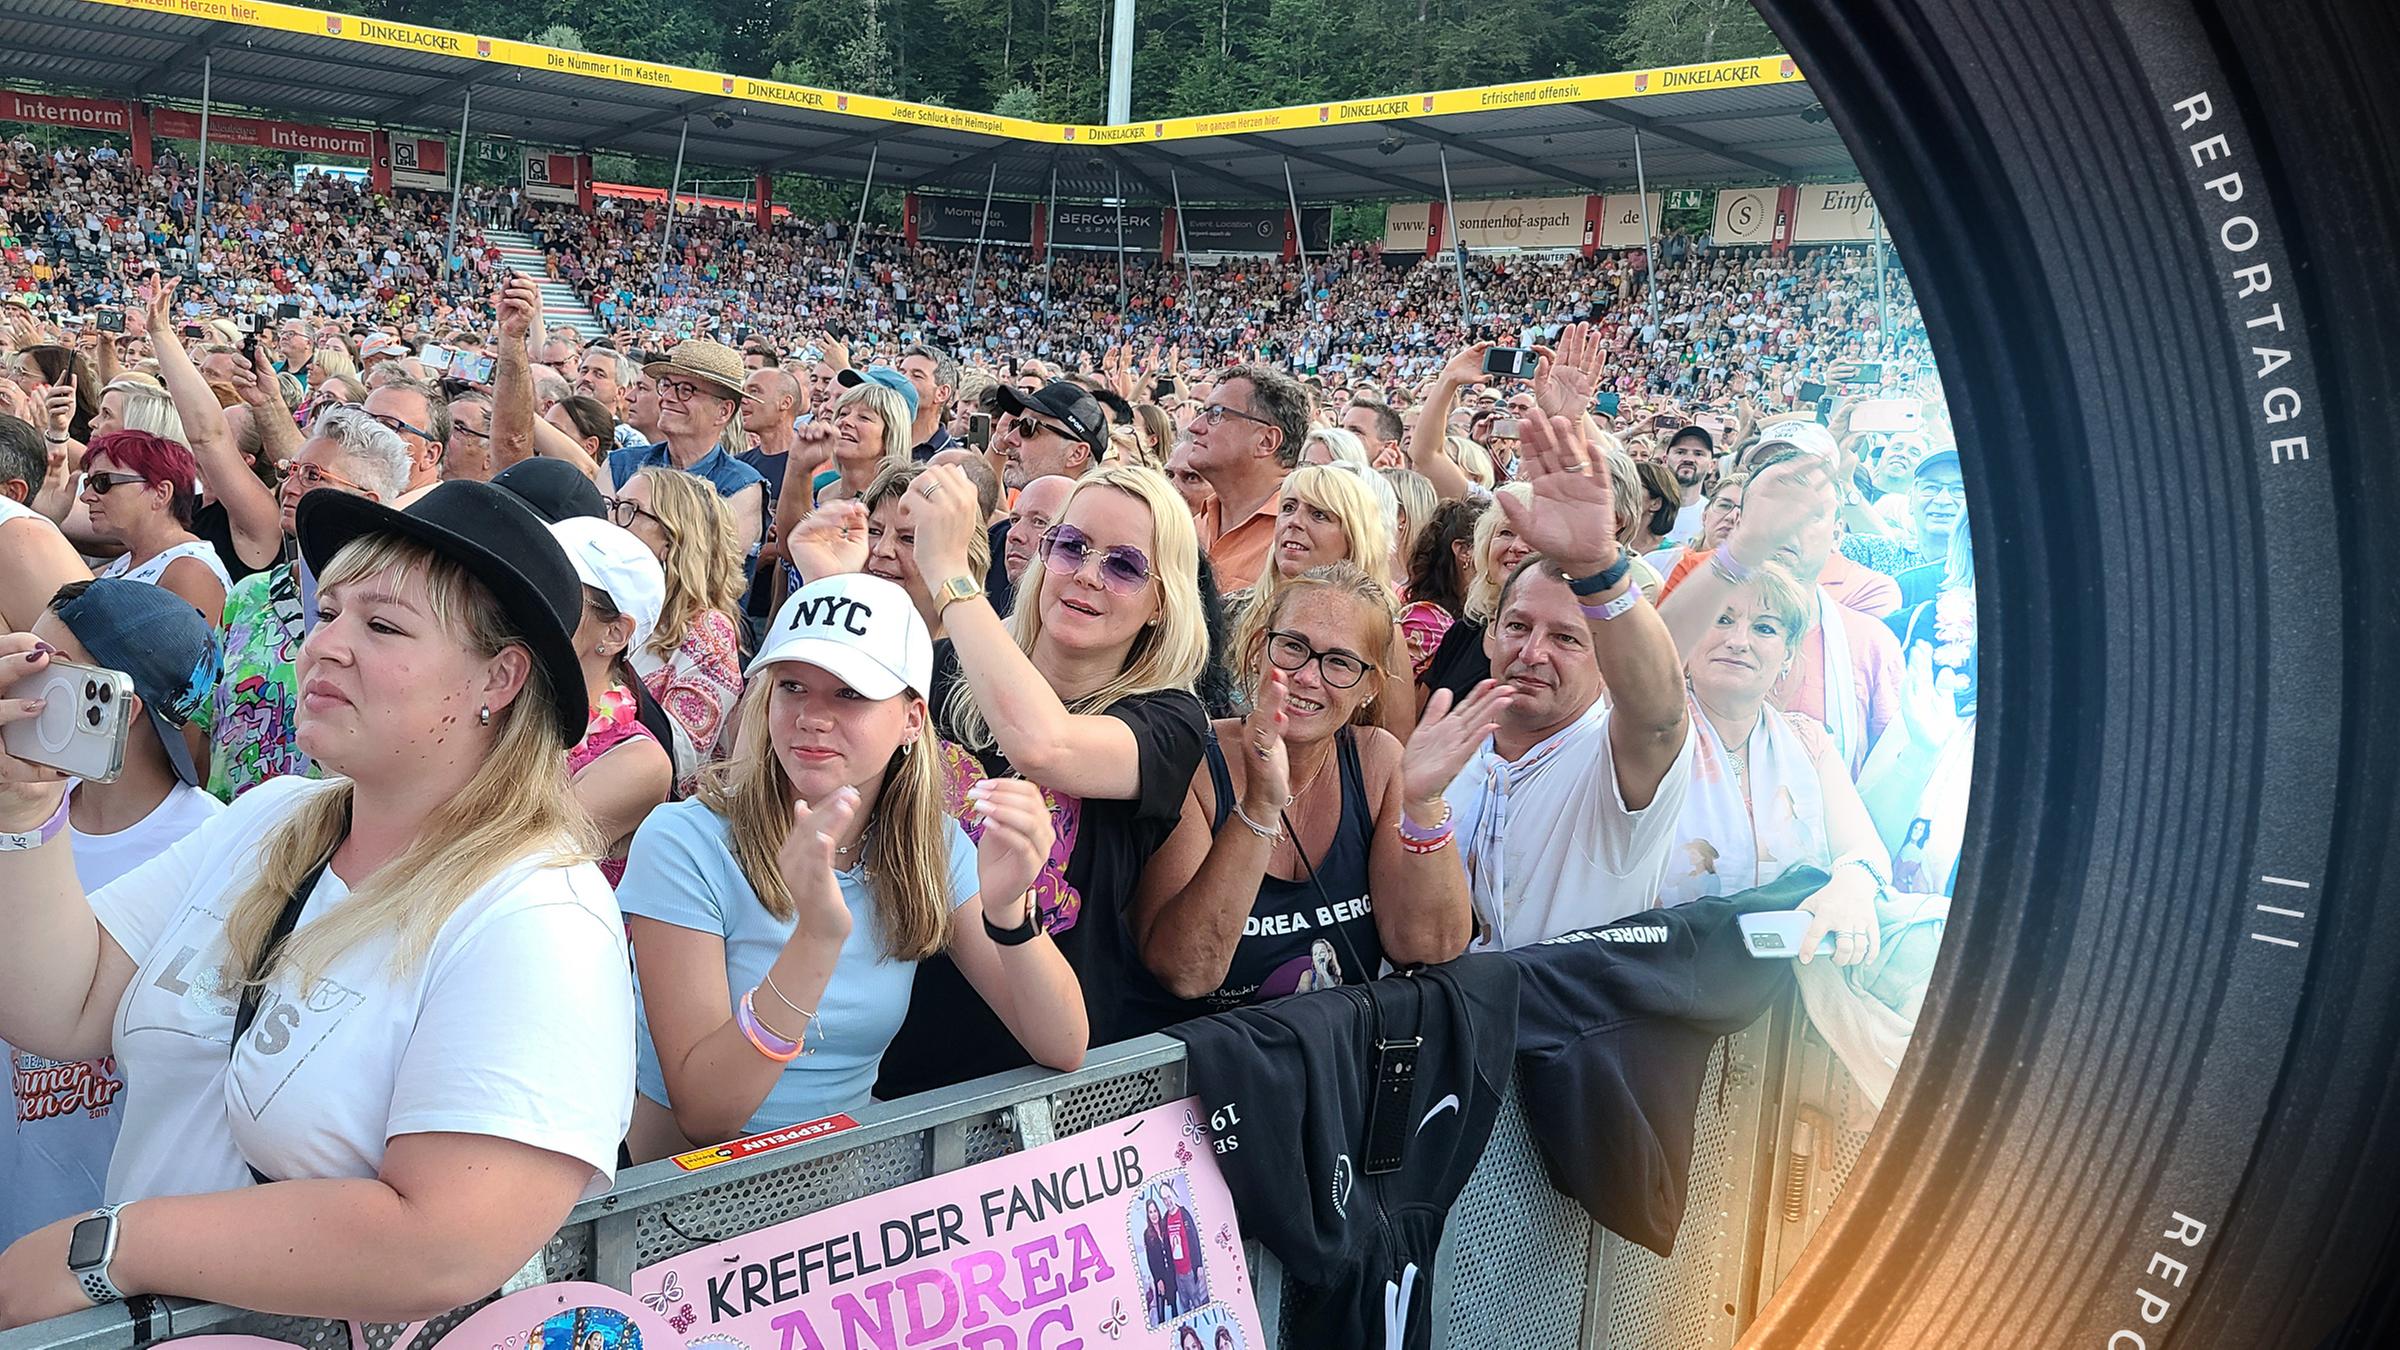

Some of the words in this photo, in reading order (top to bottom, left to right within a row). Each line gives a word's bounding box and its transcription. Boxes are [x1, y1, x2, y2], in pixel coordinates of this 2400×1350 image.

[180, 0, 227, 17] Herzen
[231, 7, 260, 21] hier.
[359, 21, 461, 51] DINKELACKER
[547, 53, 565, 67] Die
[567, 55, 611, 74] Nummer
[613, 63, 619, 76] 1
[620, 64, 633, 78] im
[636, 66, 673, 84] Kasten.
[1662, 64, 1761, 88] DINKELACKER
[747, 82, 824, 107] DINKELACKER
[1481, 90, 1536, 105] Erfrischend
[1538, 84, 1581, 100] offensiv.
[14, 98, 122, 126] Internorm
[891, 106, 916, 120] Jeder
[918, 109, 949, 125] Schluck
[950, 114, 963, 126] ein
[964, 116, 1005, 133] Heimspiel.
[1340, 101, 1410, 118] DINKELACKER
[1087, 127, 1146, 141] DINKELACKER
[1195, 120, 1209, 133] Von
[1209, 118, 1237, 133] ganzem
[1238, 116, 1262, 130] Herzen
[1263, 114, 1281, 128] hier.
[271, 128, 366, 153] Internorm
[379, 156, 388, 167] C
[1059, 212, 1151, 228] BERGWERK
[1392, 221, 1426, 232] www.
[1459, 212, 1570, 232] sonnenhof-aspach
[1587, 222, 1593, 231] F
[1619, 209, 1640, 225] .de
[1777, 214, 1785, 225] F
[1286, 231, 1292, 240] E
[1429, 226, 1436, 236] E
[788, 596, 873, 637] NYC
[1242, 912, 1312, 937] DREA
[1315, 893, 1372, 927] BERG
[1593, 926, 1668, 944] ANDREA
[60, 1074, 124, 1114] Air
[89, 1106, 110, 1120] 2019
[742, 1121, 837, 1152] ZEPPELIN
[706, 1205, 964, 1324] KREFELDER
[982, 1145, 1144, 1238] FANCLUB
[769, 1222, 1116, 1350] ANDREA
